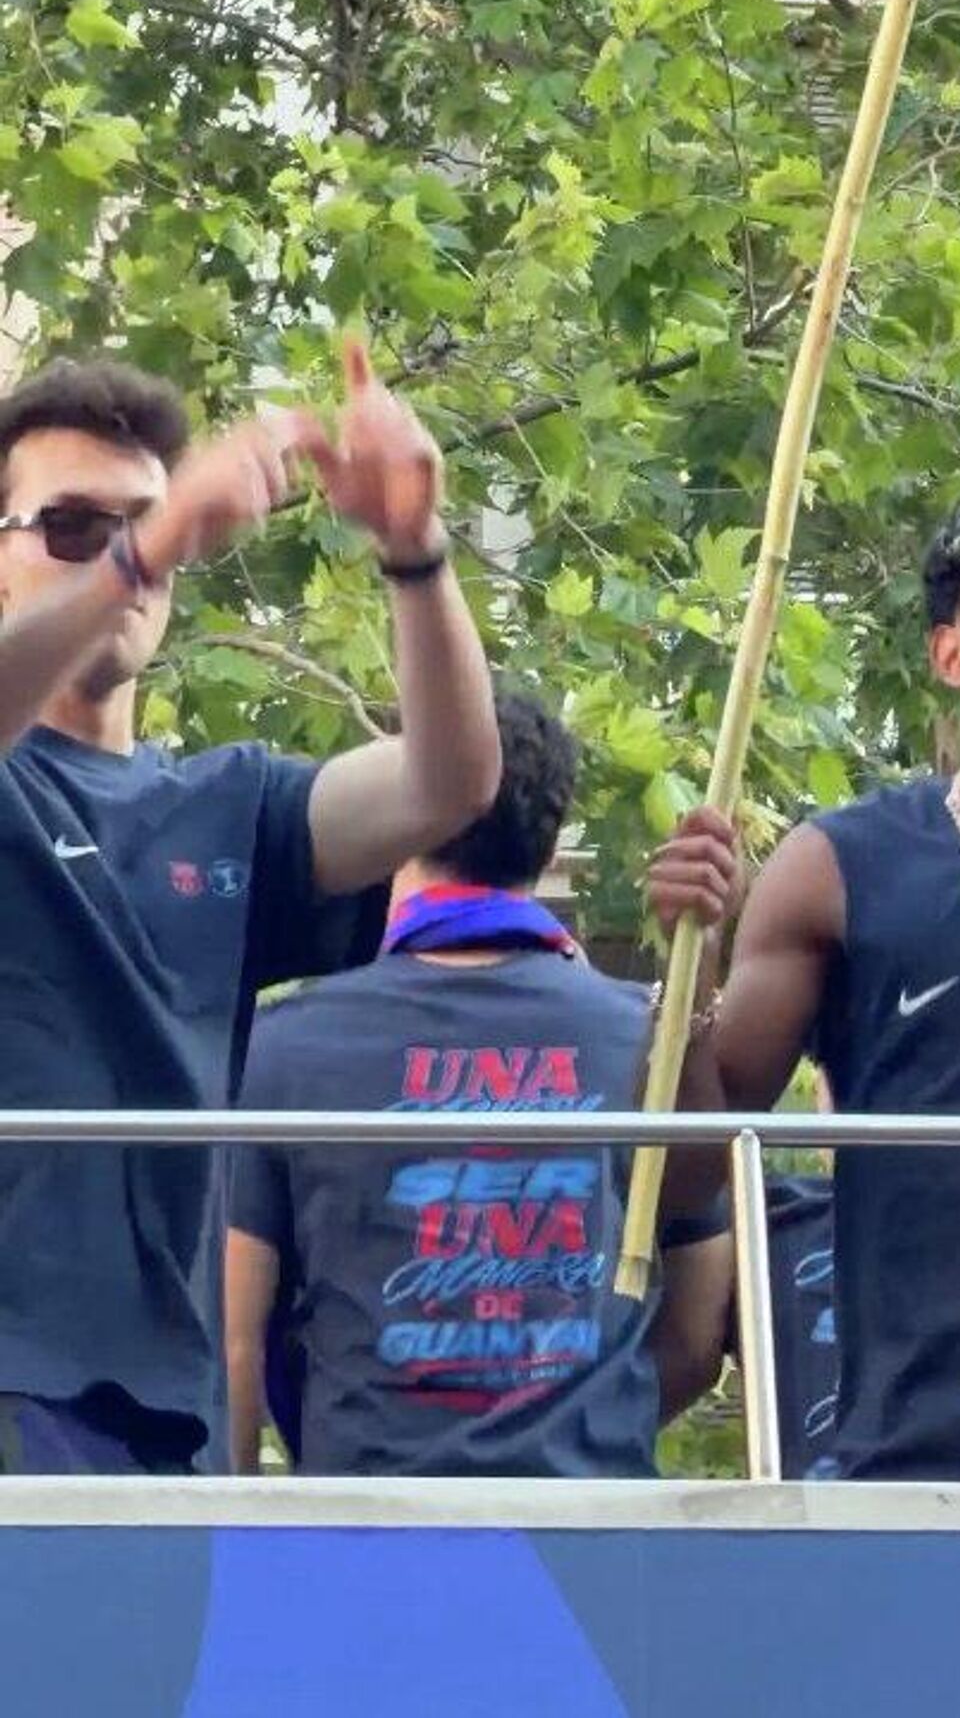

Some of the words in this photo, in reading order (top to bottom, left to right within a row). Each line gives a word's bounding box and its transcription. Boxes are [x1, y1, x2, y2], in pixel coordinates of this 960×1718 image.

[402, 1046, 579, 1100] UNA
[387, 1159, 597, 1204] SER
[416, 1202, 588, 1259] UNA
